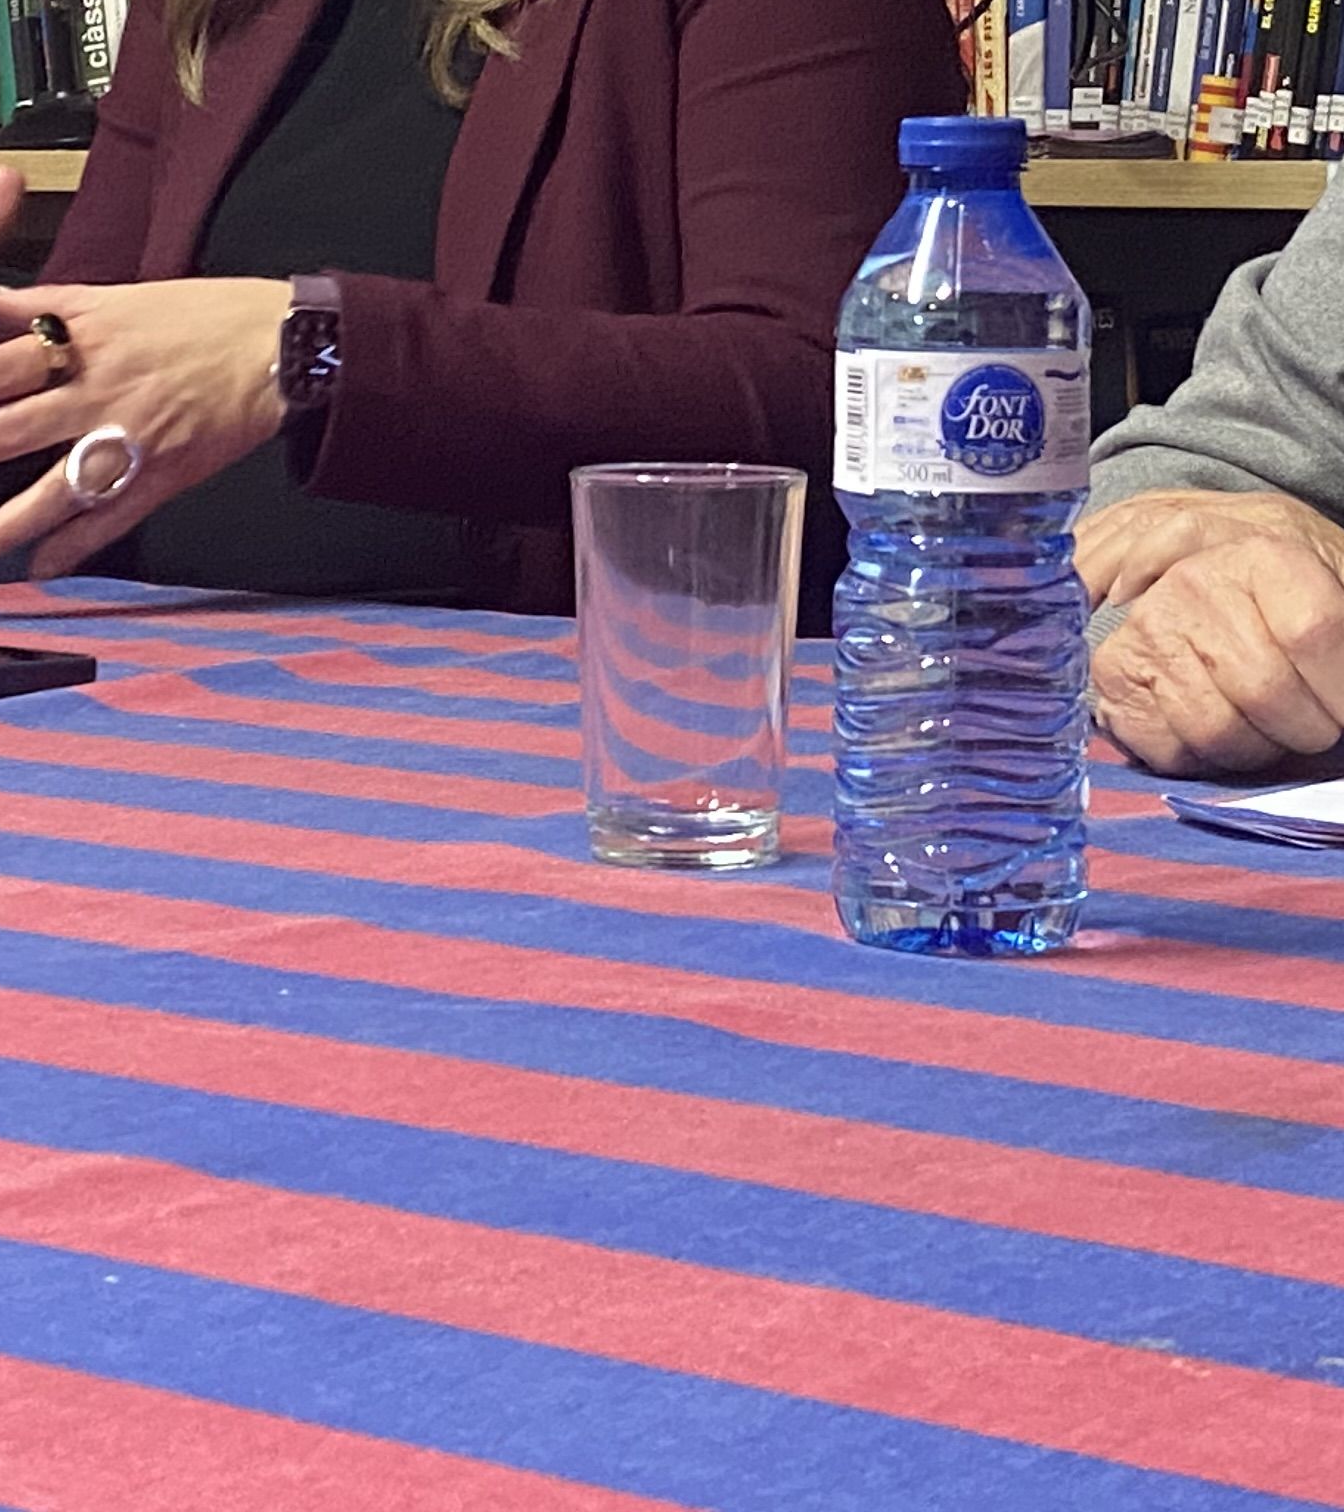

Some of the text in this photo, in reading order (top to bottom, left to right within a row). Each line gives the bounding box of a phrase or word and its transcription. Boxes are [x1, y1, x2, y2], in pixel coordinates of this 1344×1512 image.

[965, 415, 1030, 444] DOR
[897, 463, 954, 483] 500 ml
